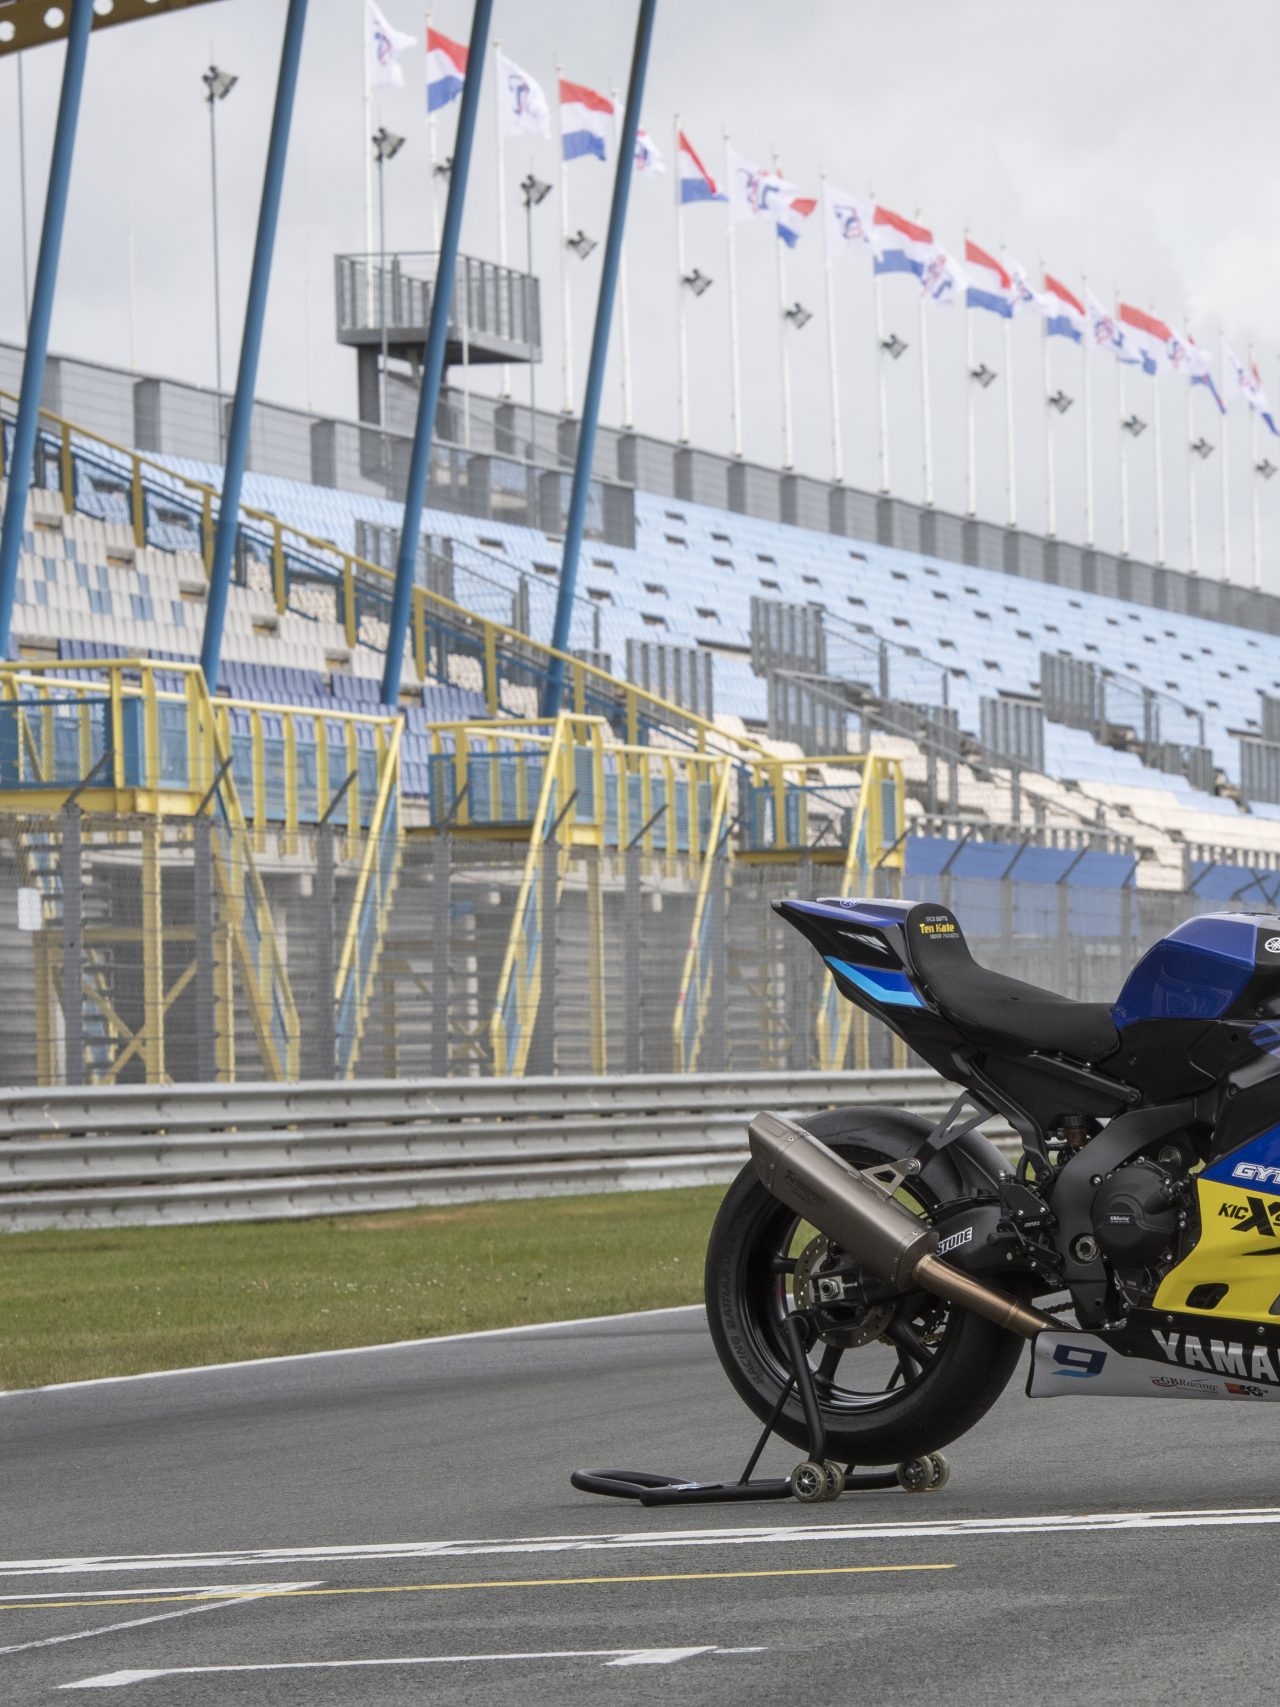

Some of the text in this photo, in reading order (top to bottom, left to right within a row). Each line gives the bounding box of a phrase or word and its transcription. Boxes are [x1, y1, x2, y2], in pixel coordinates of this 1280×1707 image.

[920, 923, 955, 934] Ten Kate
[1051, 1344, 1107, 1378] 9
